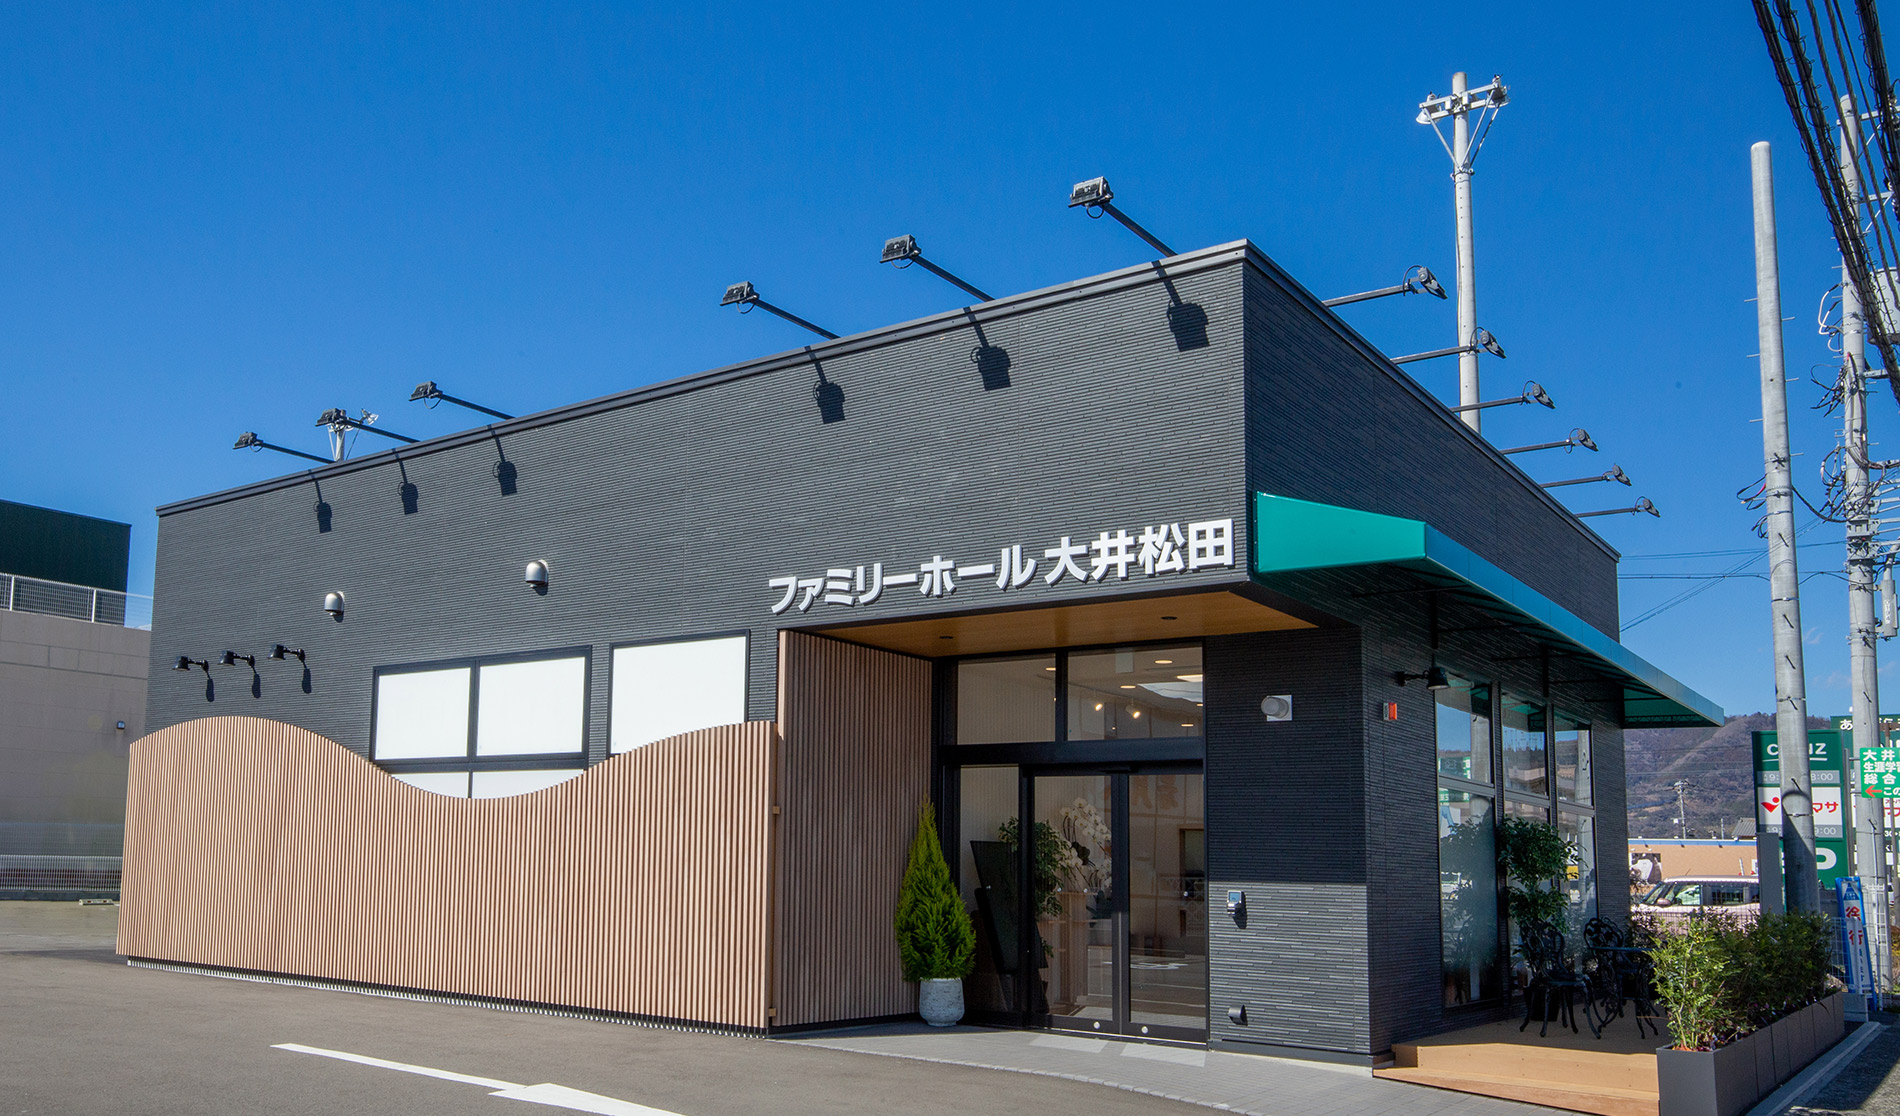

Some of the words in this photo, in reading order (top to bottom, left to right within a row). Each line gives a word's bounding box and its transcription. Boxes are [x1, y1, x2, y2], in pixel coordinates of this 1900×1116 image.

[768, 544, 1037, 615] ファミリーホール
[1044, 518, 1235, 585] 大井松田
[1863, 749, 1900, 761] 大井
[1812, 801, 1839, 813] マサ
